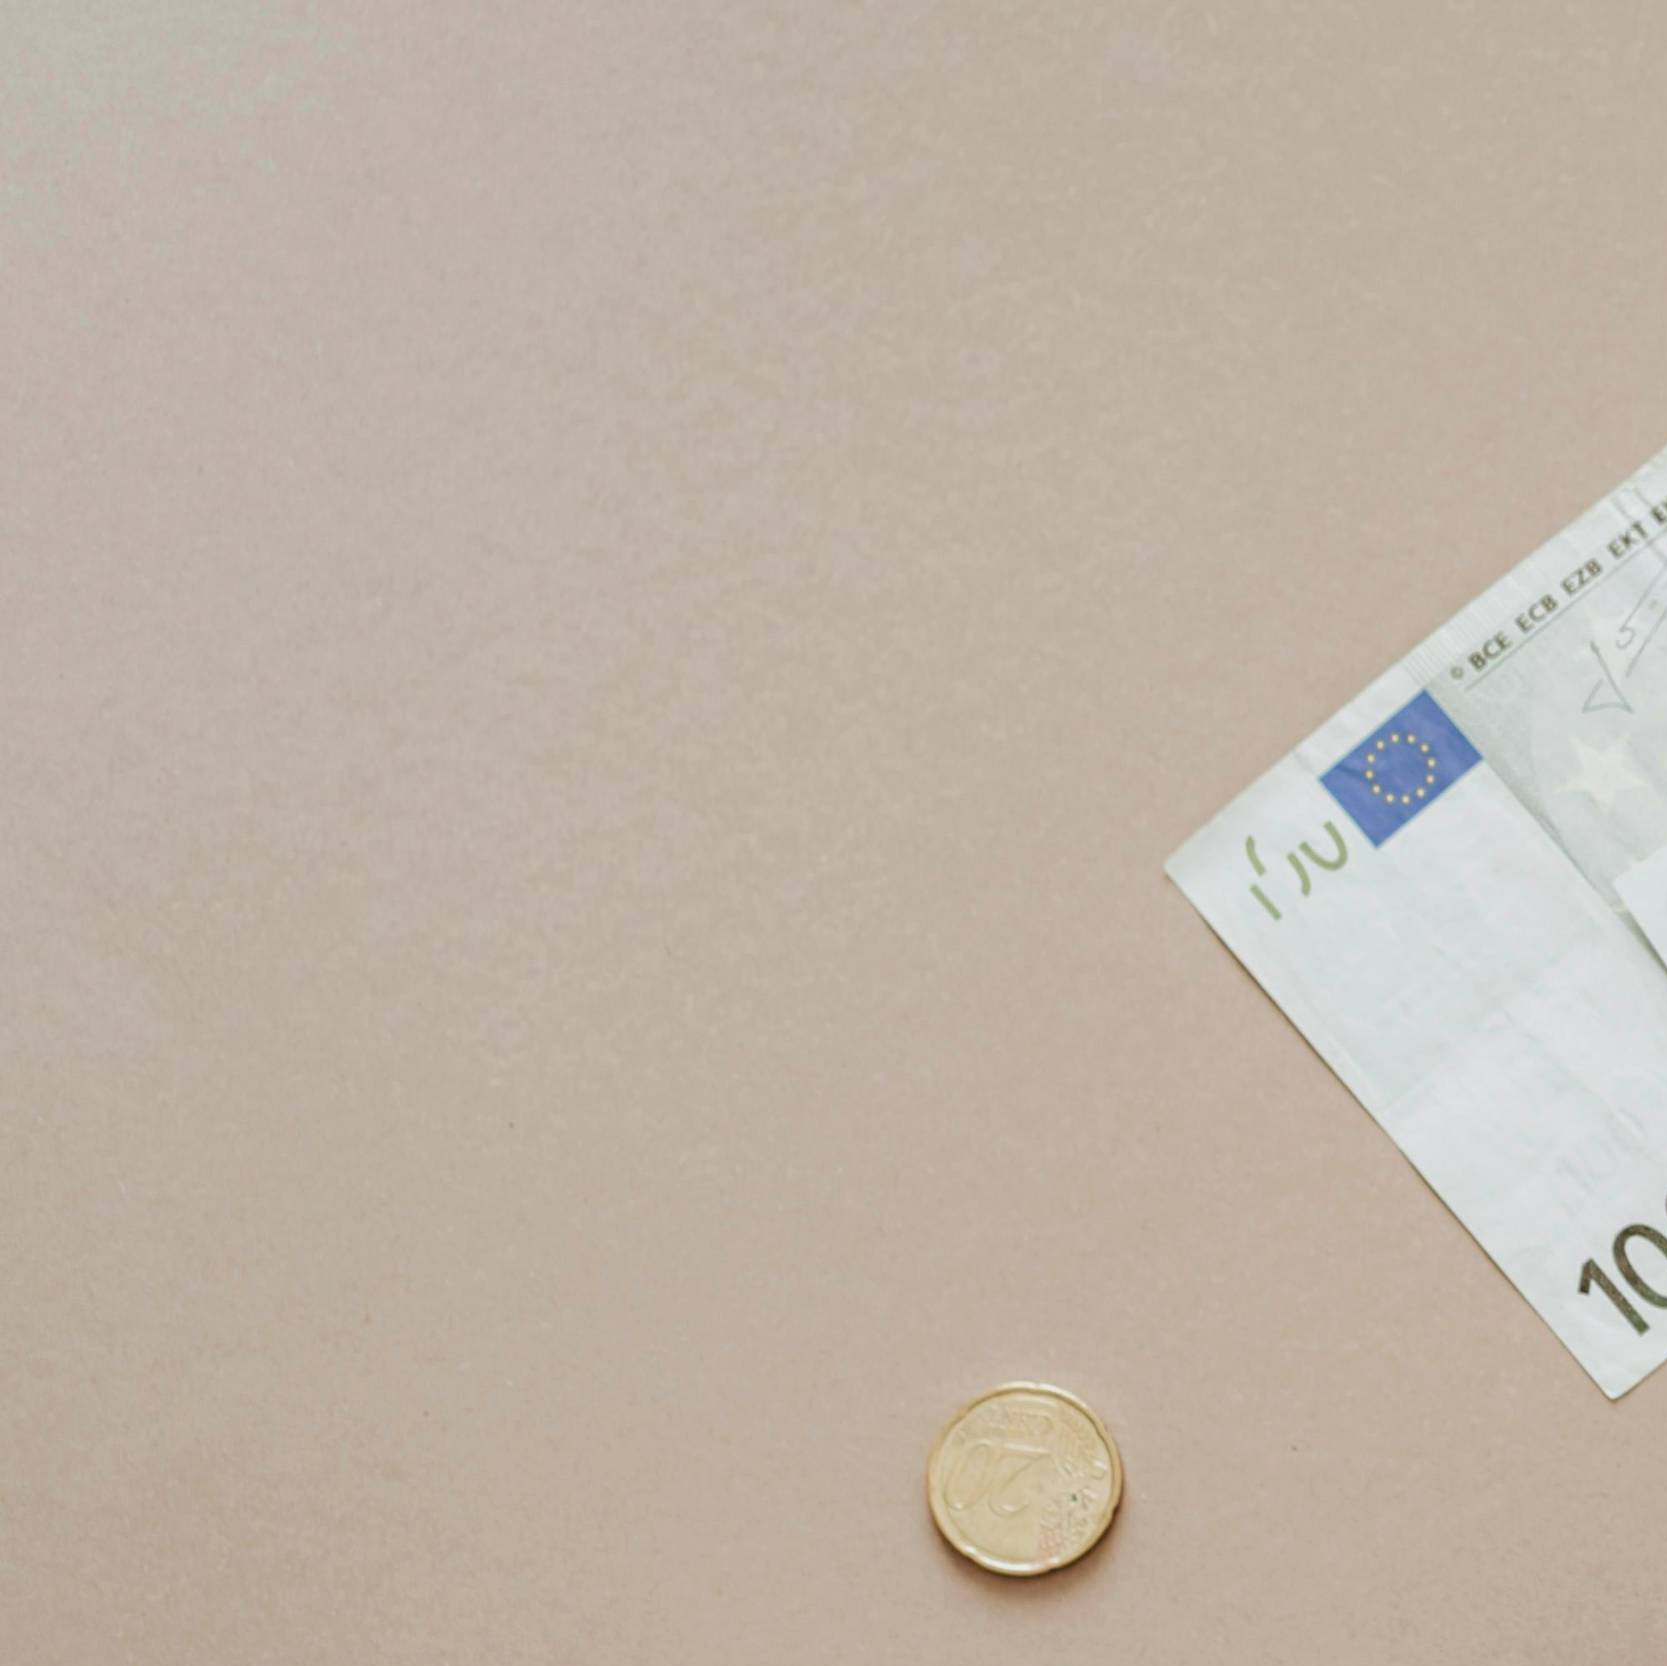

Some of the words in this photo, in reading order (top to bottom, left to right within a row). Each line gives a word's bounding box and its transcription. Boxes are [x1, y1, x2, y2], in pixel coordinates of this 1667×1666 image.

[1467, 632, 1513, 673] BCE
[1515, 594, 1559, 634] ECB
[1560, 558, 1604, 597] EZB
[1606, 520, 1650, 560] EKT
